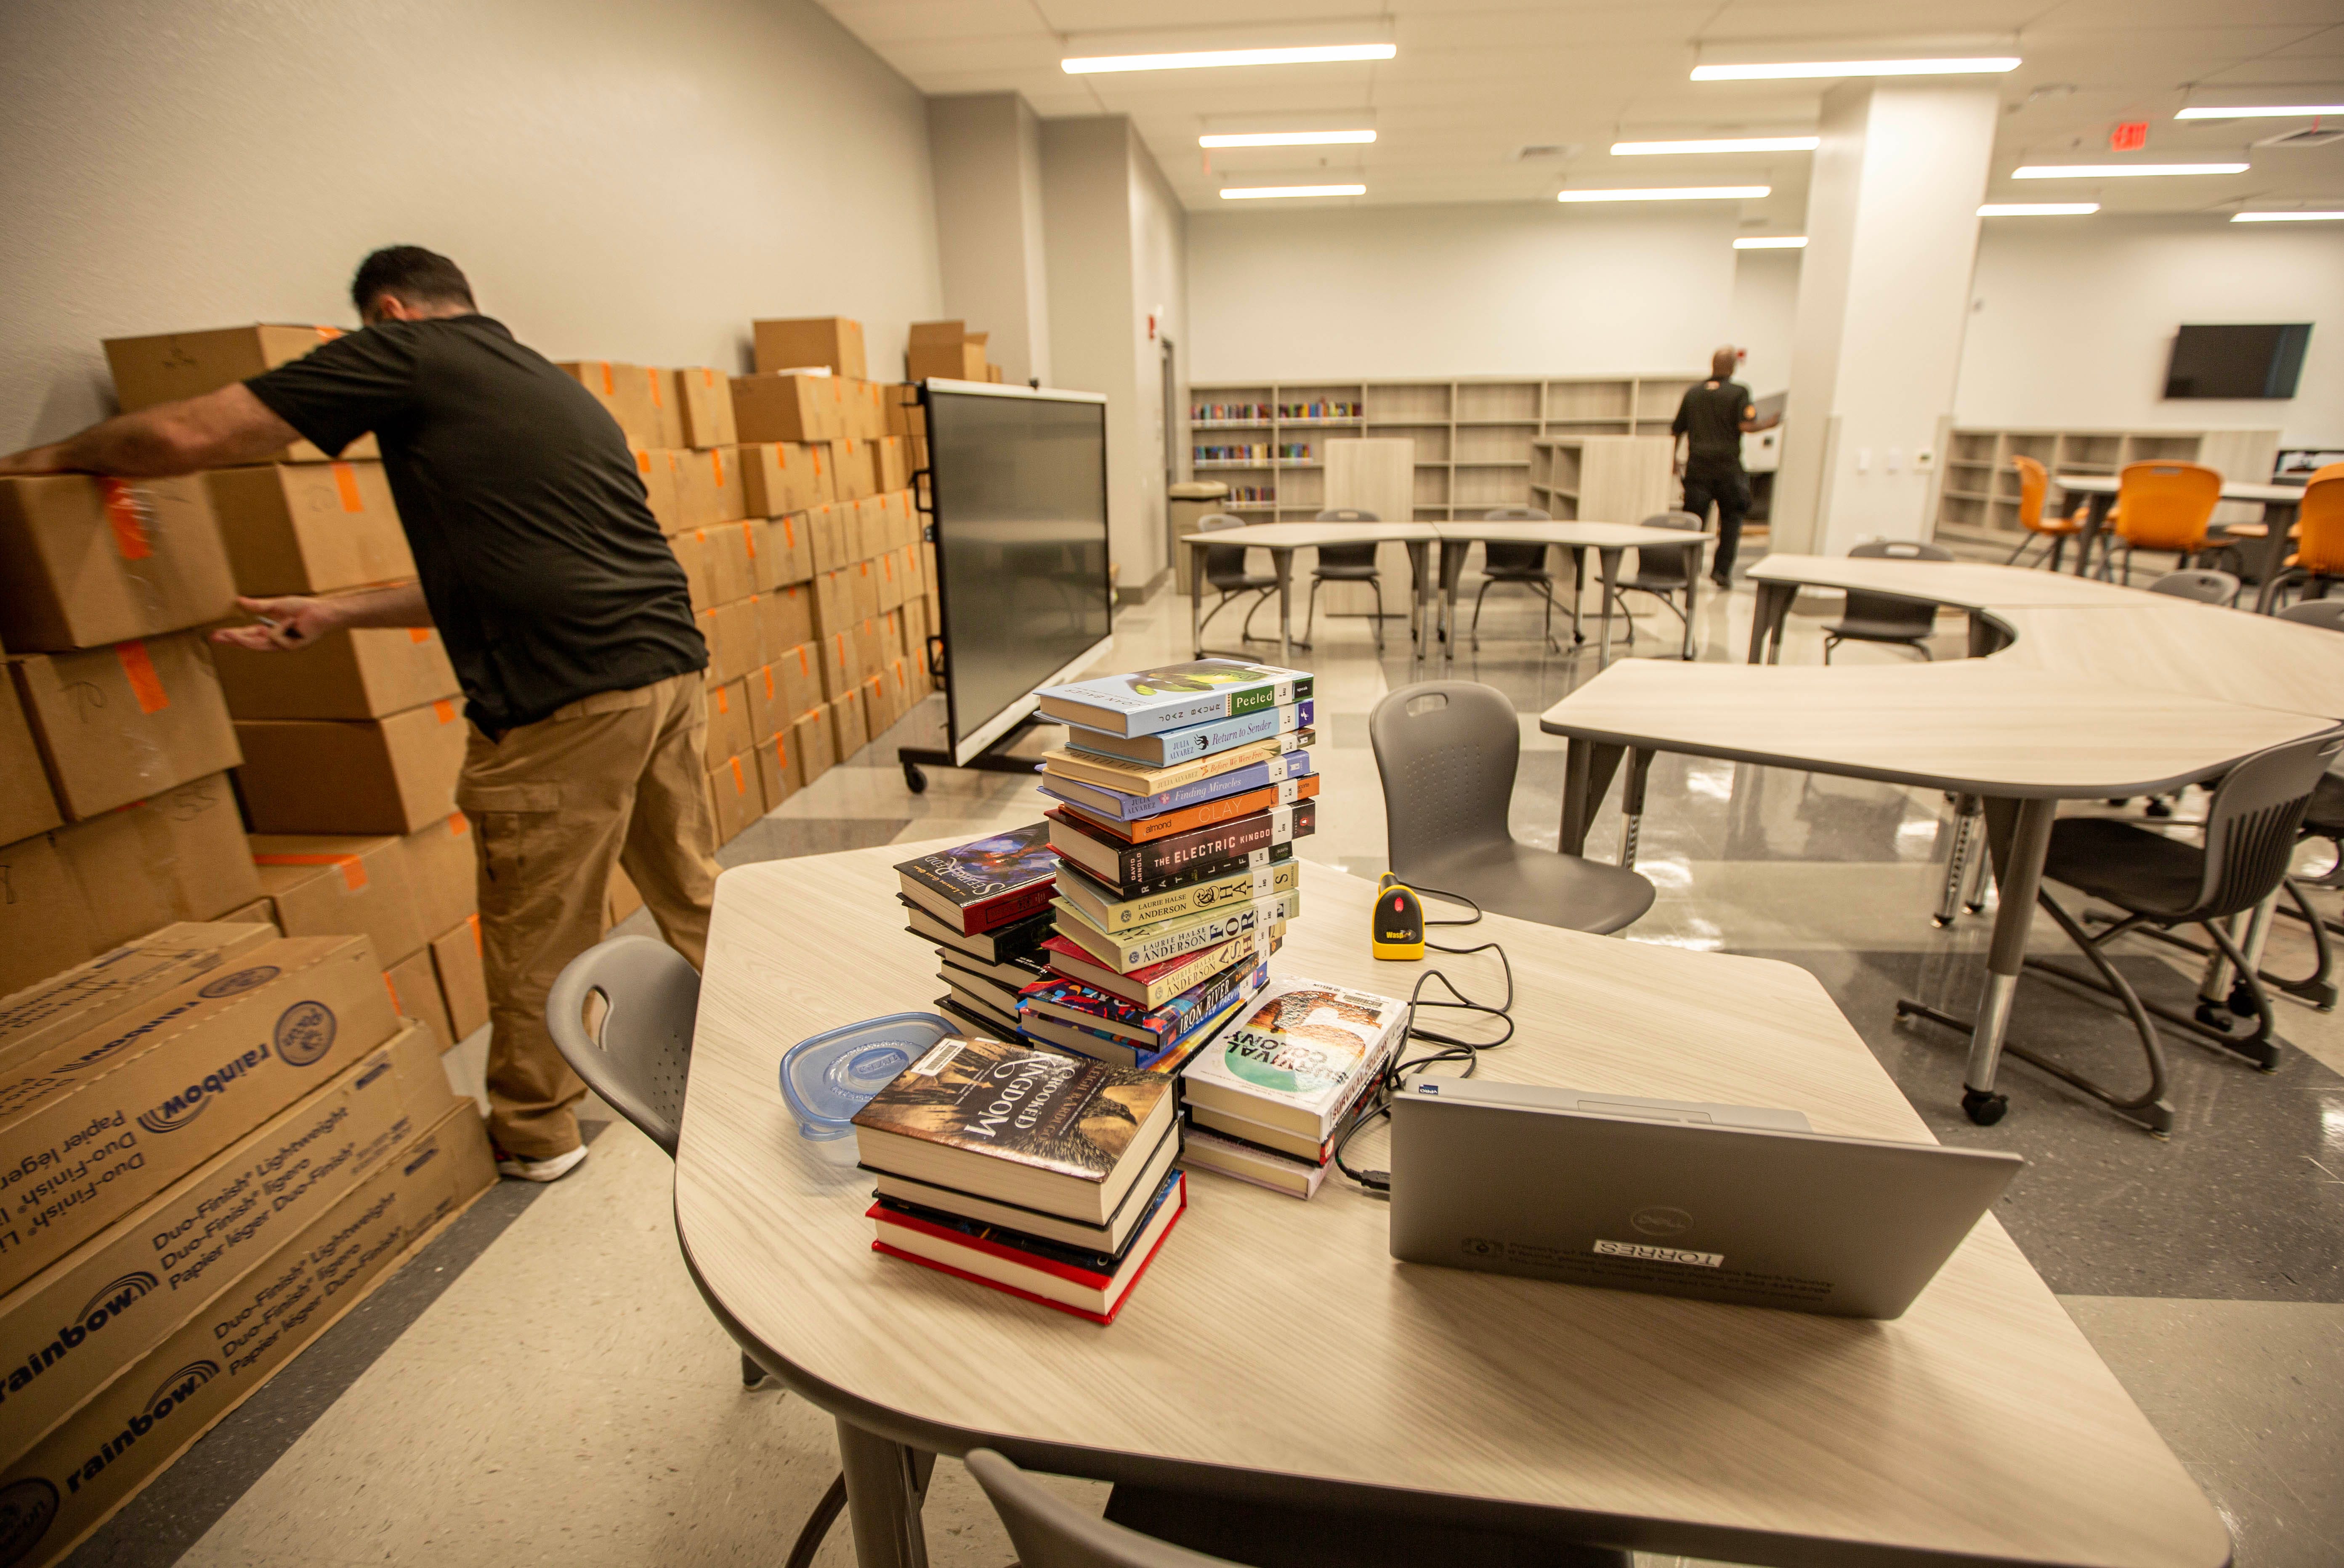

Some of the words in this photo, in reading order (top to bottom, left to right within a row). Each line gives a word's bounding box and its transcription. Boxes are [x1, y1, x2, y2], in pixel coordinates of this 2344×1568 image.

[1064, 689, 1105, 699] BAUER
[1106, 697, 1141, 706] JOAN
[1236, 691, 1273, 708] Peeled
[1159, 712, 1183, 722] JOAN
[1191, 704, 1220, 715] BAUER
[1173, 740, 1189, 750] JULIA
[1212, 732, 1238, 746] Return
[1247, 720, 1272, 736] Sender
[1169, 747, 1194, 760] ALVAREZ
[1210, 762, 1229, 773] Before
[1238, 754, 1252, 763] Were
[1252, 751, 1263, 759] Free
[1157, 779, 1173, 789] JULIA
[1174, 771, 1198, 785] ALVAREZ
[1175, 786, 1207, 801] Finding
[1207, 778, 1241, 794] Miracles
[1127, 802, 1156, 815] ALVAREZ
[1132, 797, 1151, 806] JULIA
[1199, 798, 1243, 823] CLAY
[1145, 821, 1172, 834] almond
[1154, 856, 1170, 867] THE
[1174, 836, 1236, 864] ELECTRIC
[1240, 827, 1273, 844] KINGDO
[940, 880, 960, 893] LOOKING
[1138, 898, 1164, 910] LAURIE
[1165, 893, 1186, 904] HALSE
[1138, 903, 1187, 921] ANDERSON
[1143, 937, 1175, 951] LAURIE
[1179, 926, 1206, 941] HALSE
[1143, 933, 1207, 962] ANDERSON
[1167, 967, 1192, 985] LAURIE
[1194, 953, 1215, 970] HALSE
[1167, 961, 1216, 997] ANDERSON
[1236, 964, 1251, 982] DANIEL
[1180, 1002, 1203, 1035] IRON
[1206, 979, 1230, 1011] RIVER
[79, 1000, 202, 1062] rainbow
[163, 1040, 273, 1120] rainbow
[1077, 1065, 1104, 1091] LEIGH
[1331, 1071, 1364, 1121] SURVIVAL
[1365, 1039, 1388, 1076] COLONY
[964, 1050, 1064, 1138] KINGDOM
[1014, 1066, 1075, 1129] CROOKED
[1038, 1091, 1082, 1141] BARDUGO
[62, 1110, 126, 1153] Papier
[255, 1106, 349, 1177] Lightweight
[0, 1148, 61, 1190] léger
[262, 1158, 310, 1196] ligero
[309, 1192, 396, 1265] Lightweight
[168, 1243, 225, 1291] Papier
[225, 1209, 271, 1247] léger
[316, 1243, 361, 1281] ligero
[1600, 1243, 1716, 1266] TORRES
[0, 1286, 132, 1404] rainbow
[229, 1329, 280, 1376] Papier
[66, 1375, 196, 1494] rainbow
